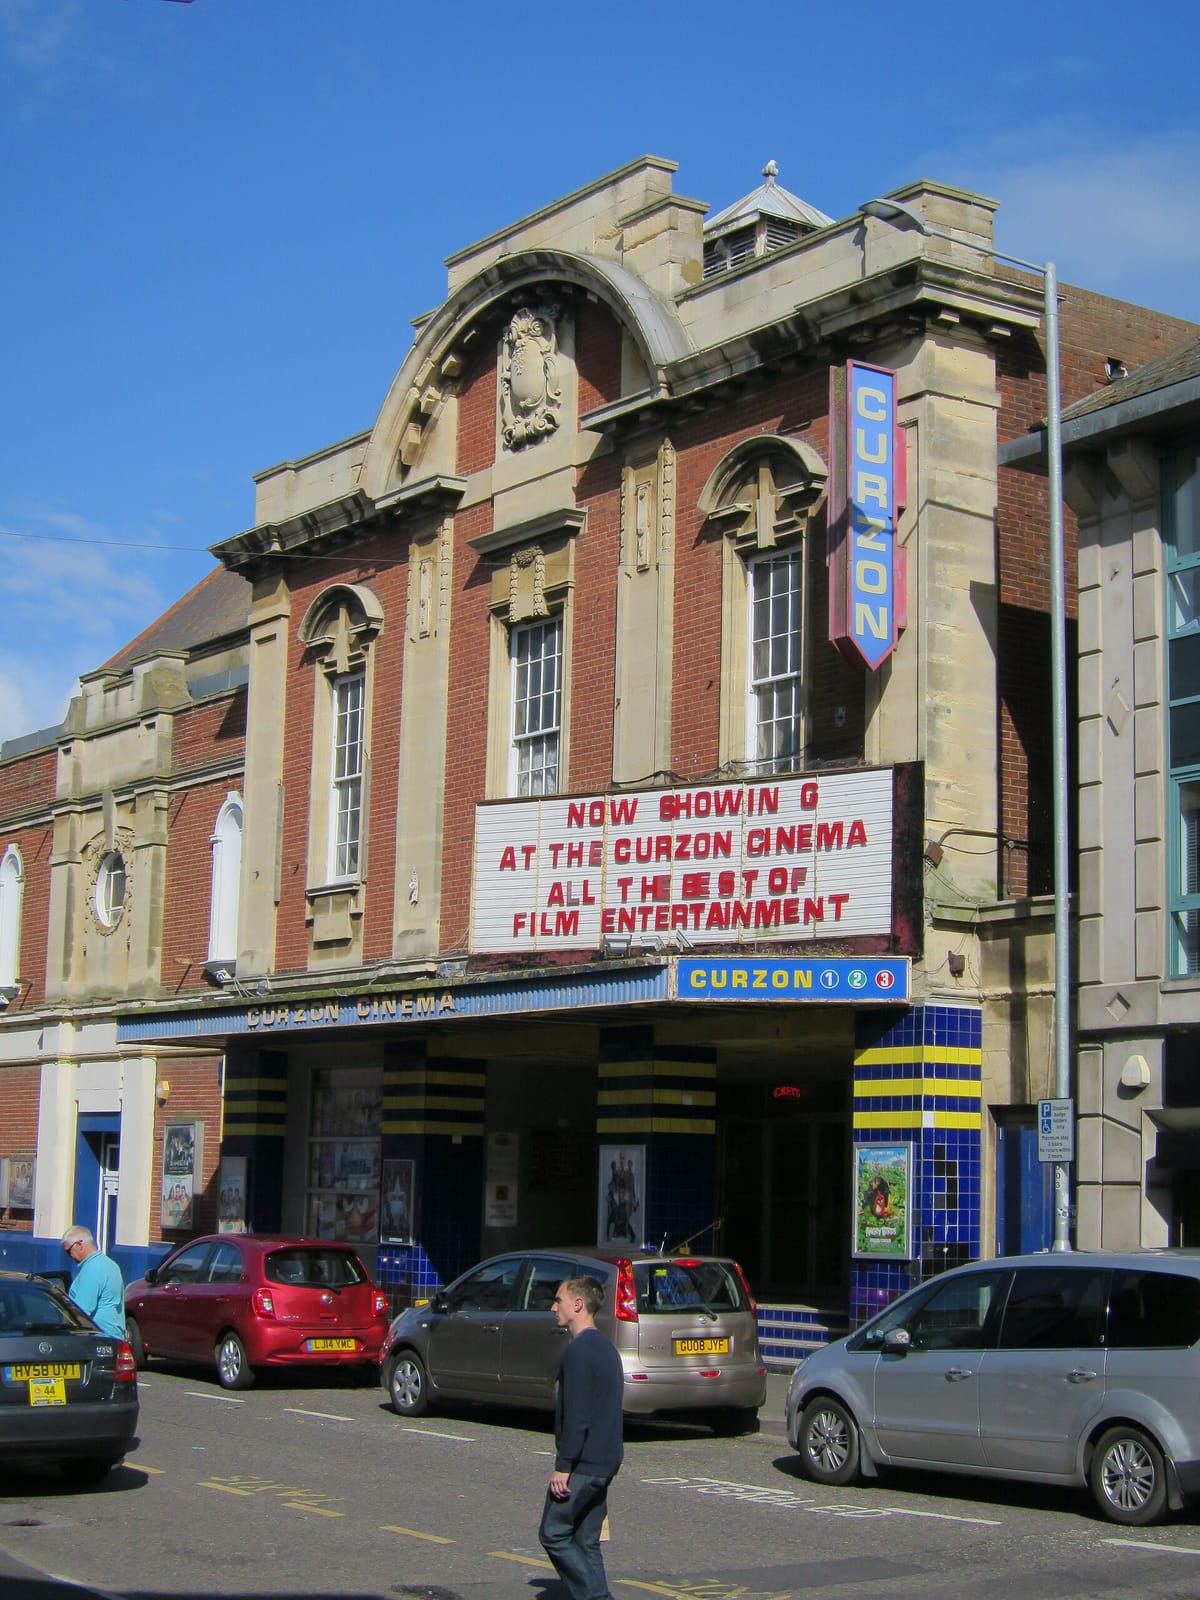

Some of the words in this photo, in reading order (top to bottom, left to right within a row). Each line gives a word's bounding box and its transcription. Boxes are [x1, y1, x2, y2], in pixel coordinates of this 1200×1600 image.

[856, 387, 888, 640] CURZON
[567, 798, 638, 828] NOW
[499, 845, 536, 870] AT
[549, 841, 603, 868] THE
[615, 831, 732, 863] CURZON
[747, 819, 867, 857] CINEMA
[548, 879, 595, 906] ALL
[617, 874, 671, 902] THE
[682, 870, 759, 900] BEST
[768, 867, 807, 895] OF
[513, 911, 579, 937] FILM
[602, 893, 849, 933] ENTERTAINMENT
[690, 970, 812, 988] CURZON
[247, 1001, 339, 1027] CURZON
[356, 990, 456, 1018] CINEMA
[314, 1339, 334, 1349] LJ14
[335, 1338, 352, 1348] YMC
[680, 1340, 704, 1351] GU08
[707, 1339, 724, 1350] JYF
[15, 1363, 49, 1377] HV58
[44, 1386, 55, 1395] 44
